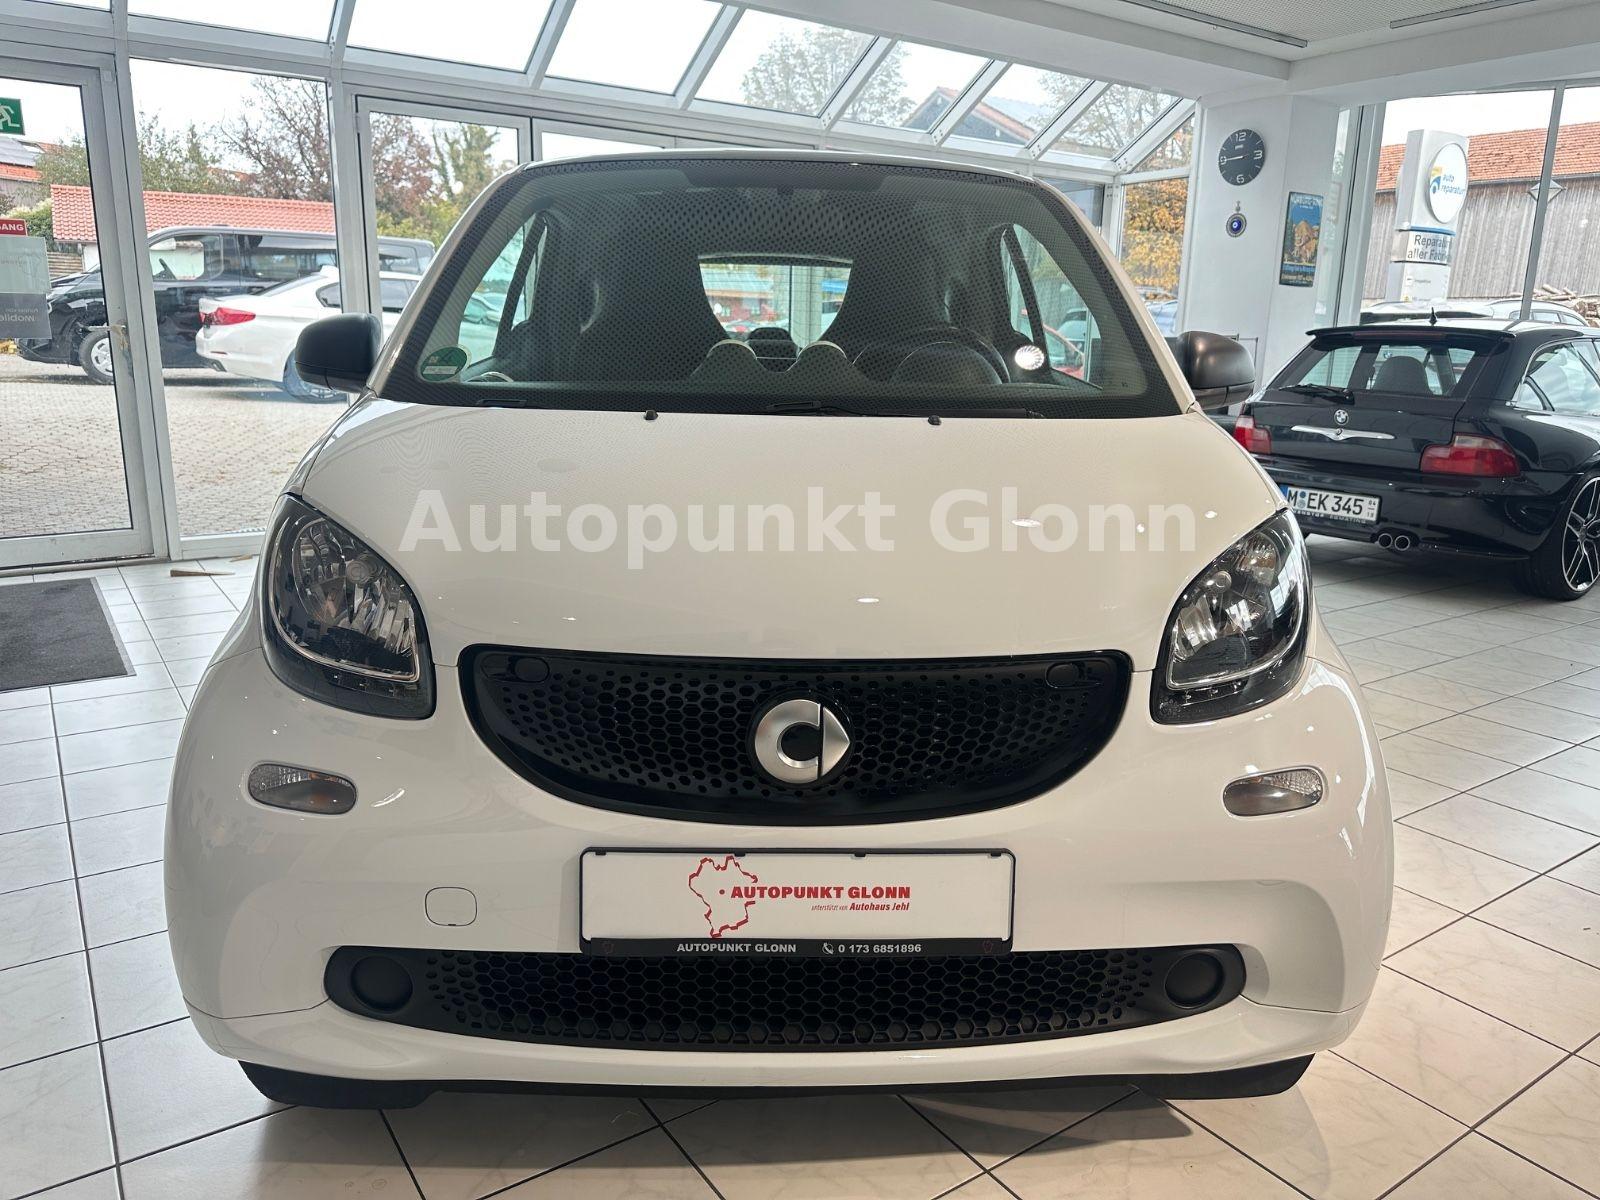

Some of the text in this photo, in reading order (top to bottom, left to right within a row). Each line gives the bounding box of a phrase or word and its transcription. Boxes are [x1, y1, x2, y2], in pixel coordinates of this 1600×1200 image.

[1235, 131, 1247, 142] 12
[1253, 149, 1263, 160] 3
[1236, 174, 1245, 184] 6
[0, 223, 24, 231] ANG
[1407, 248, 1428, 260] aller
[1287, 490, 1298, 507] M
[1307, 493, 1329, 511] EK
[1331, 495, 1364, 515] 345
[731, 886, 911, 899] AUTOPUNKT GLONN
[849, 902, 890, 911] Autohaus
[677, 943, 797, 952] AUTOPUNKT GLONN
[838, 944, 922, 953] 0 173 6851896
